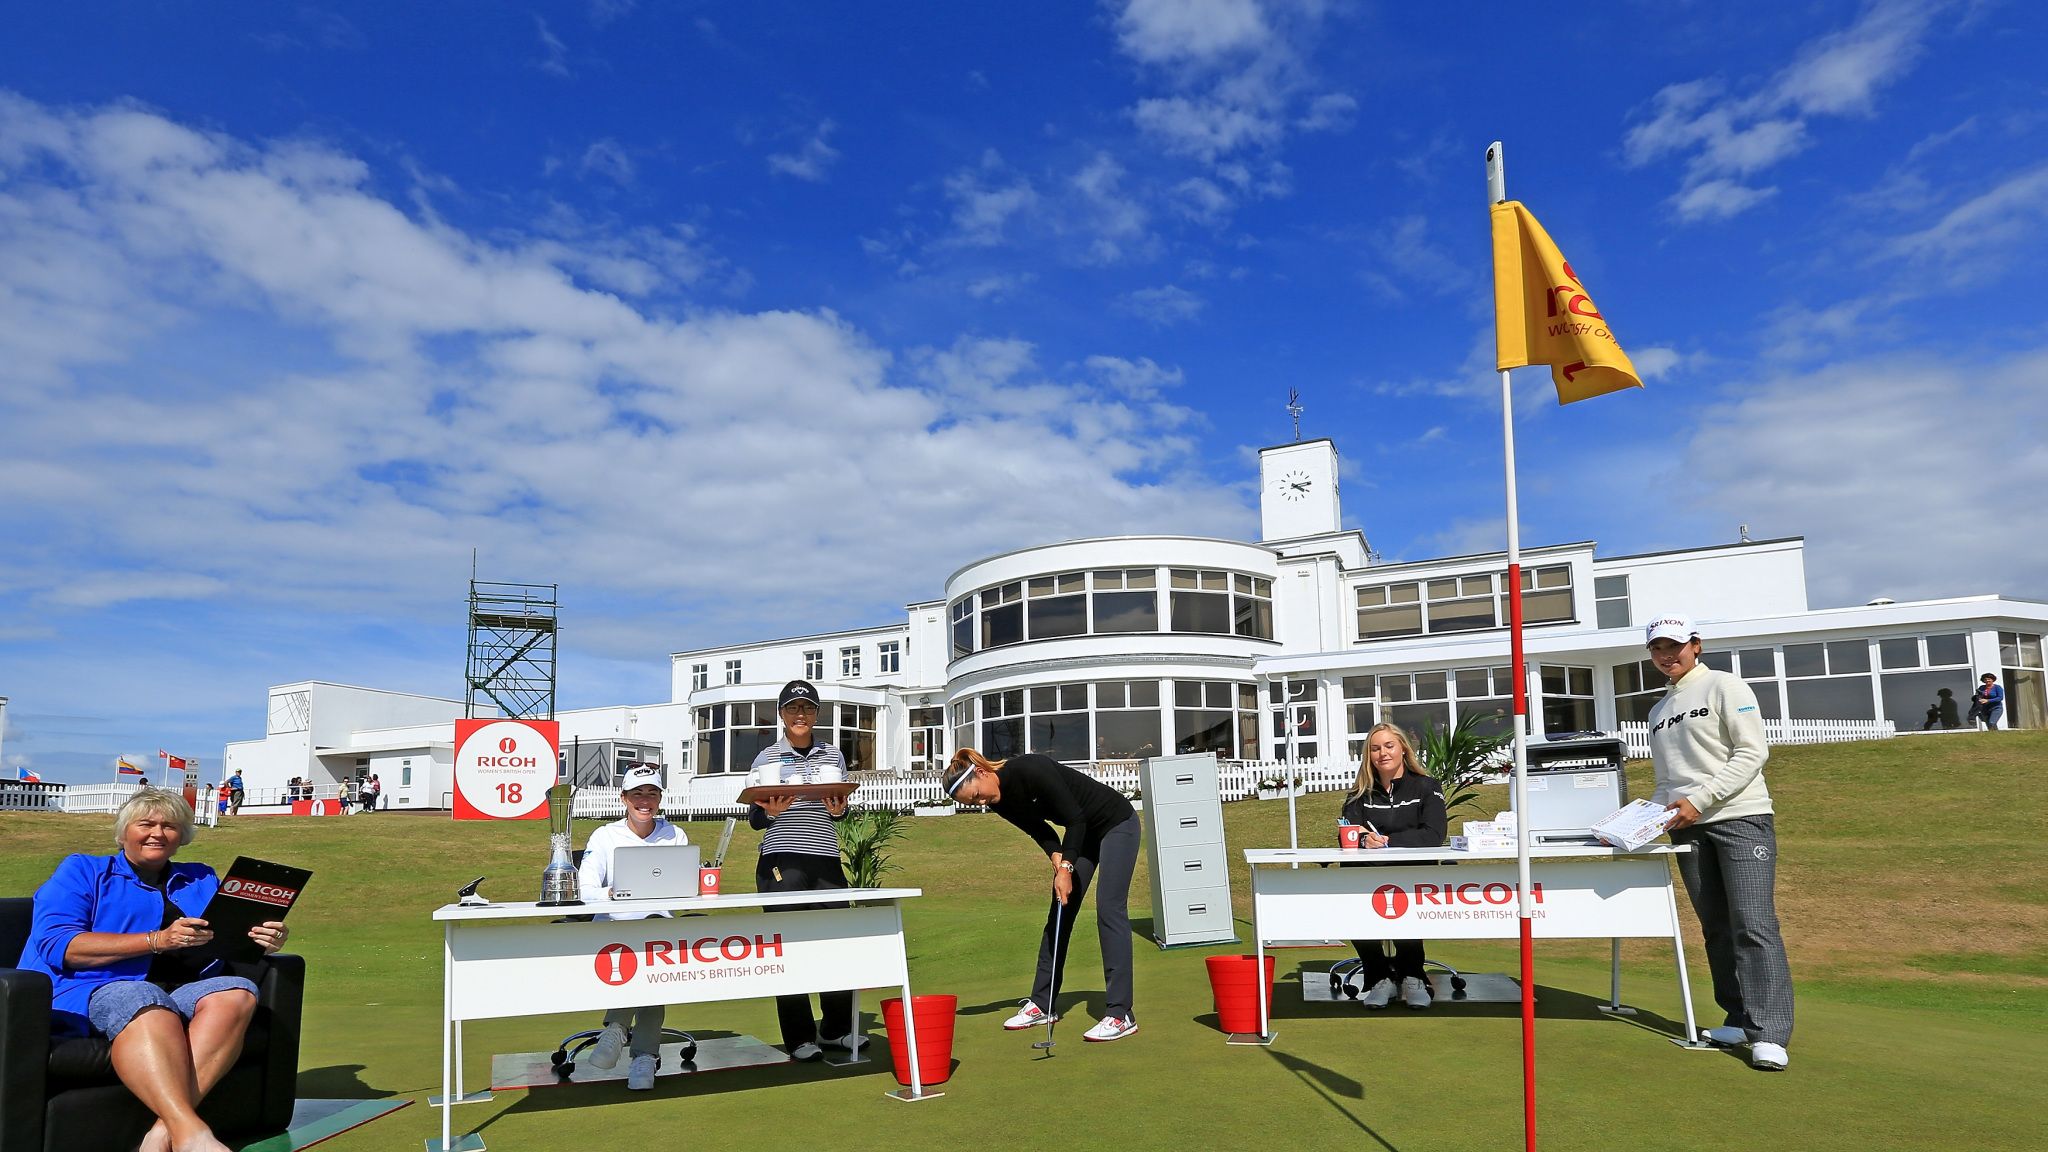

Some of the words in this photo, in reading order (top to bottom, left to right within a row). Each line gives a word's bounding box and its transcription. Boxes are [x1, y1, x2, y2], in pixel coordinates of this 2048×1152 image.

[1649, 619, 1684, 631] SRIXON
[1668, 711, 1687, 729] per
[1689, 707, 1709, 718] se
[477, 756, 536, 767] RICOH
[495, 783, 522, 804] 18
[242, 882, 295, 900] RICOH
[1414, 882, 1544, 905] RICOH
[1416, 910, 1470, 920] WOMEN'S
[1473, 910, 1513, 919] BRITISH
[1516, 910, 1546, 919] OEN
[645, 933, 783, 967] RICOH
[646, 969, 706, 984] WOMEN'S
[709, 966, 751, 979] BRITISH
[754, 964, 785, 976] OPEN
